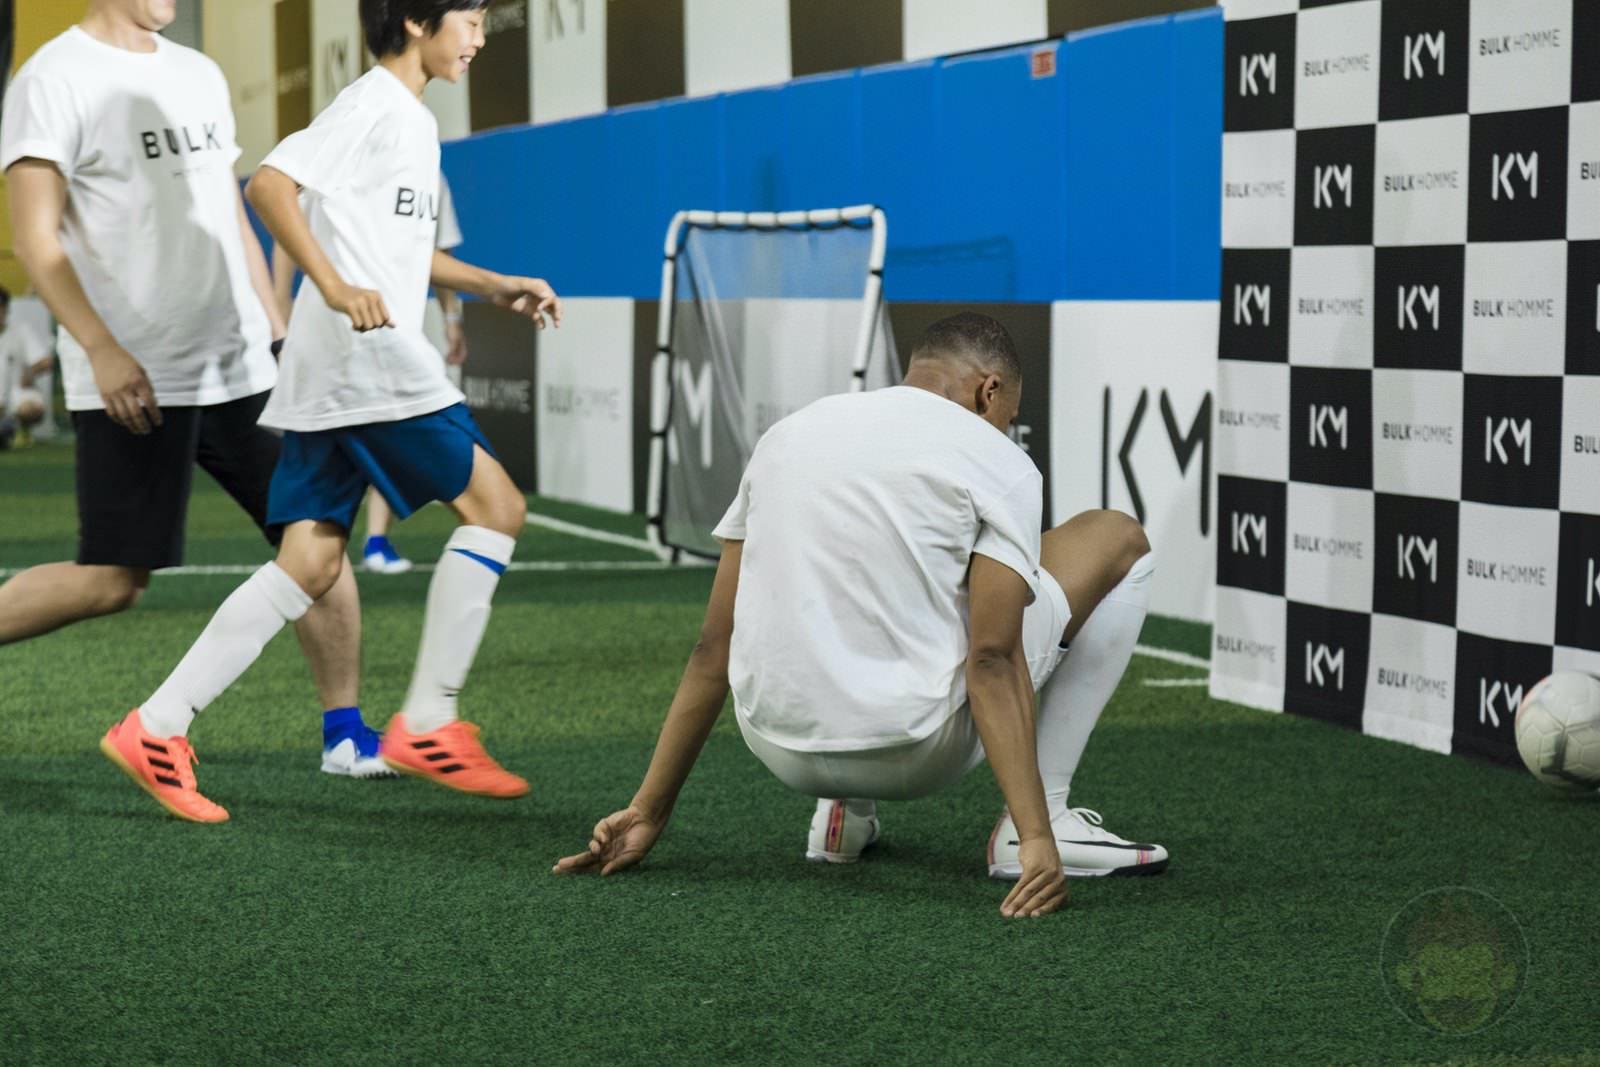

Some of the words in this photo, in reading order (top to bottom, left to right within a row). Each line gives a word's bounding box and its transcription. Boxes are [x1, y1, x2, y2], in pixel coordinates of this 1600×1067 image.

[1404, 31, 1445, 80] KM
[1480, 36, 1511, 56] BULK
[1514, 29, 1561, 52] HOMME
[1240, 53, 1276, 96] KM
[1304, 59, 1330, 77] BULK
[141, 121, 222, 159] BULK
[1314, 165, 1352, 208] KM
[1384, 175, 1415, 192] BULK
[1492, 151, 1538, 200] KM
[1235, 284, 1270, 326] KM
[1298, 299, 1325, 314] BULK
[1399, 285, 1440, 330] KM
[1473, 300, 1504, 317] BULK
[1507, 299, 1555, 318] HOMME
[1310, 404, 1347, 449] KM
[1383, 422, 1412, 440] BULK
[1486, 416, 1532, 466] KM
[1102, 386, 1213, 538] KM
[1232, 512, 1267, 557] KM
[1294, 534, 1320, 552] BULK
[1399, 534, 1438, 583] KM
[1467, 559, 1497, 580] BULK
[1500, 564, 1547, 586] HOMME
[1306, 642, 1344, 690] KM
[1378, 668, 1408, 688] BULK
